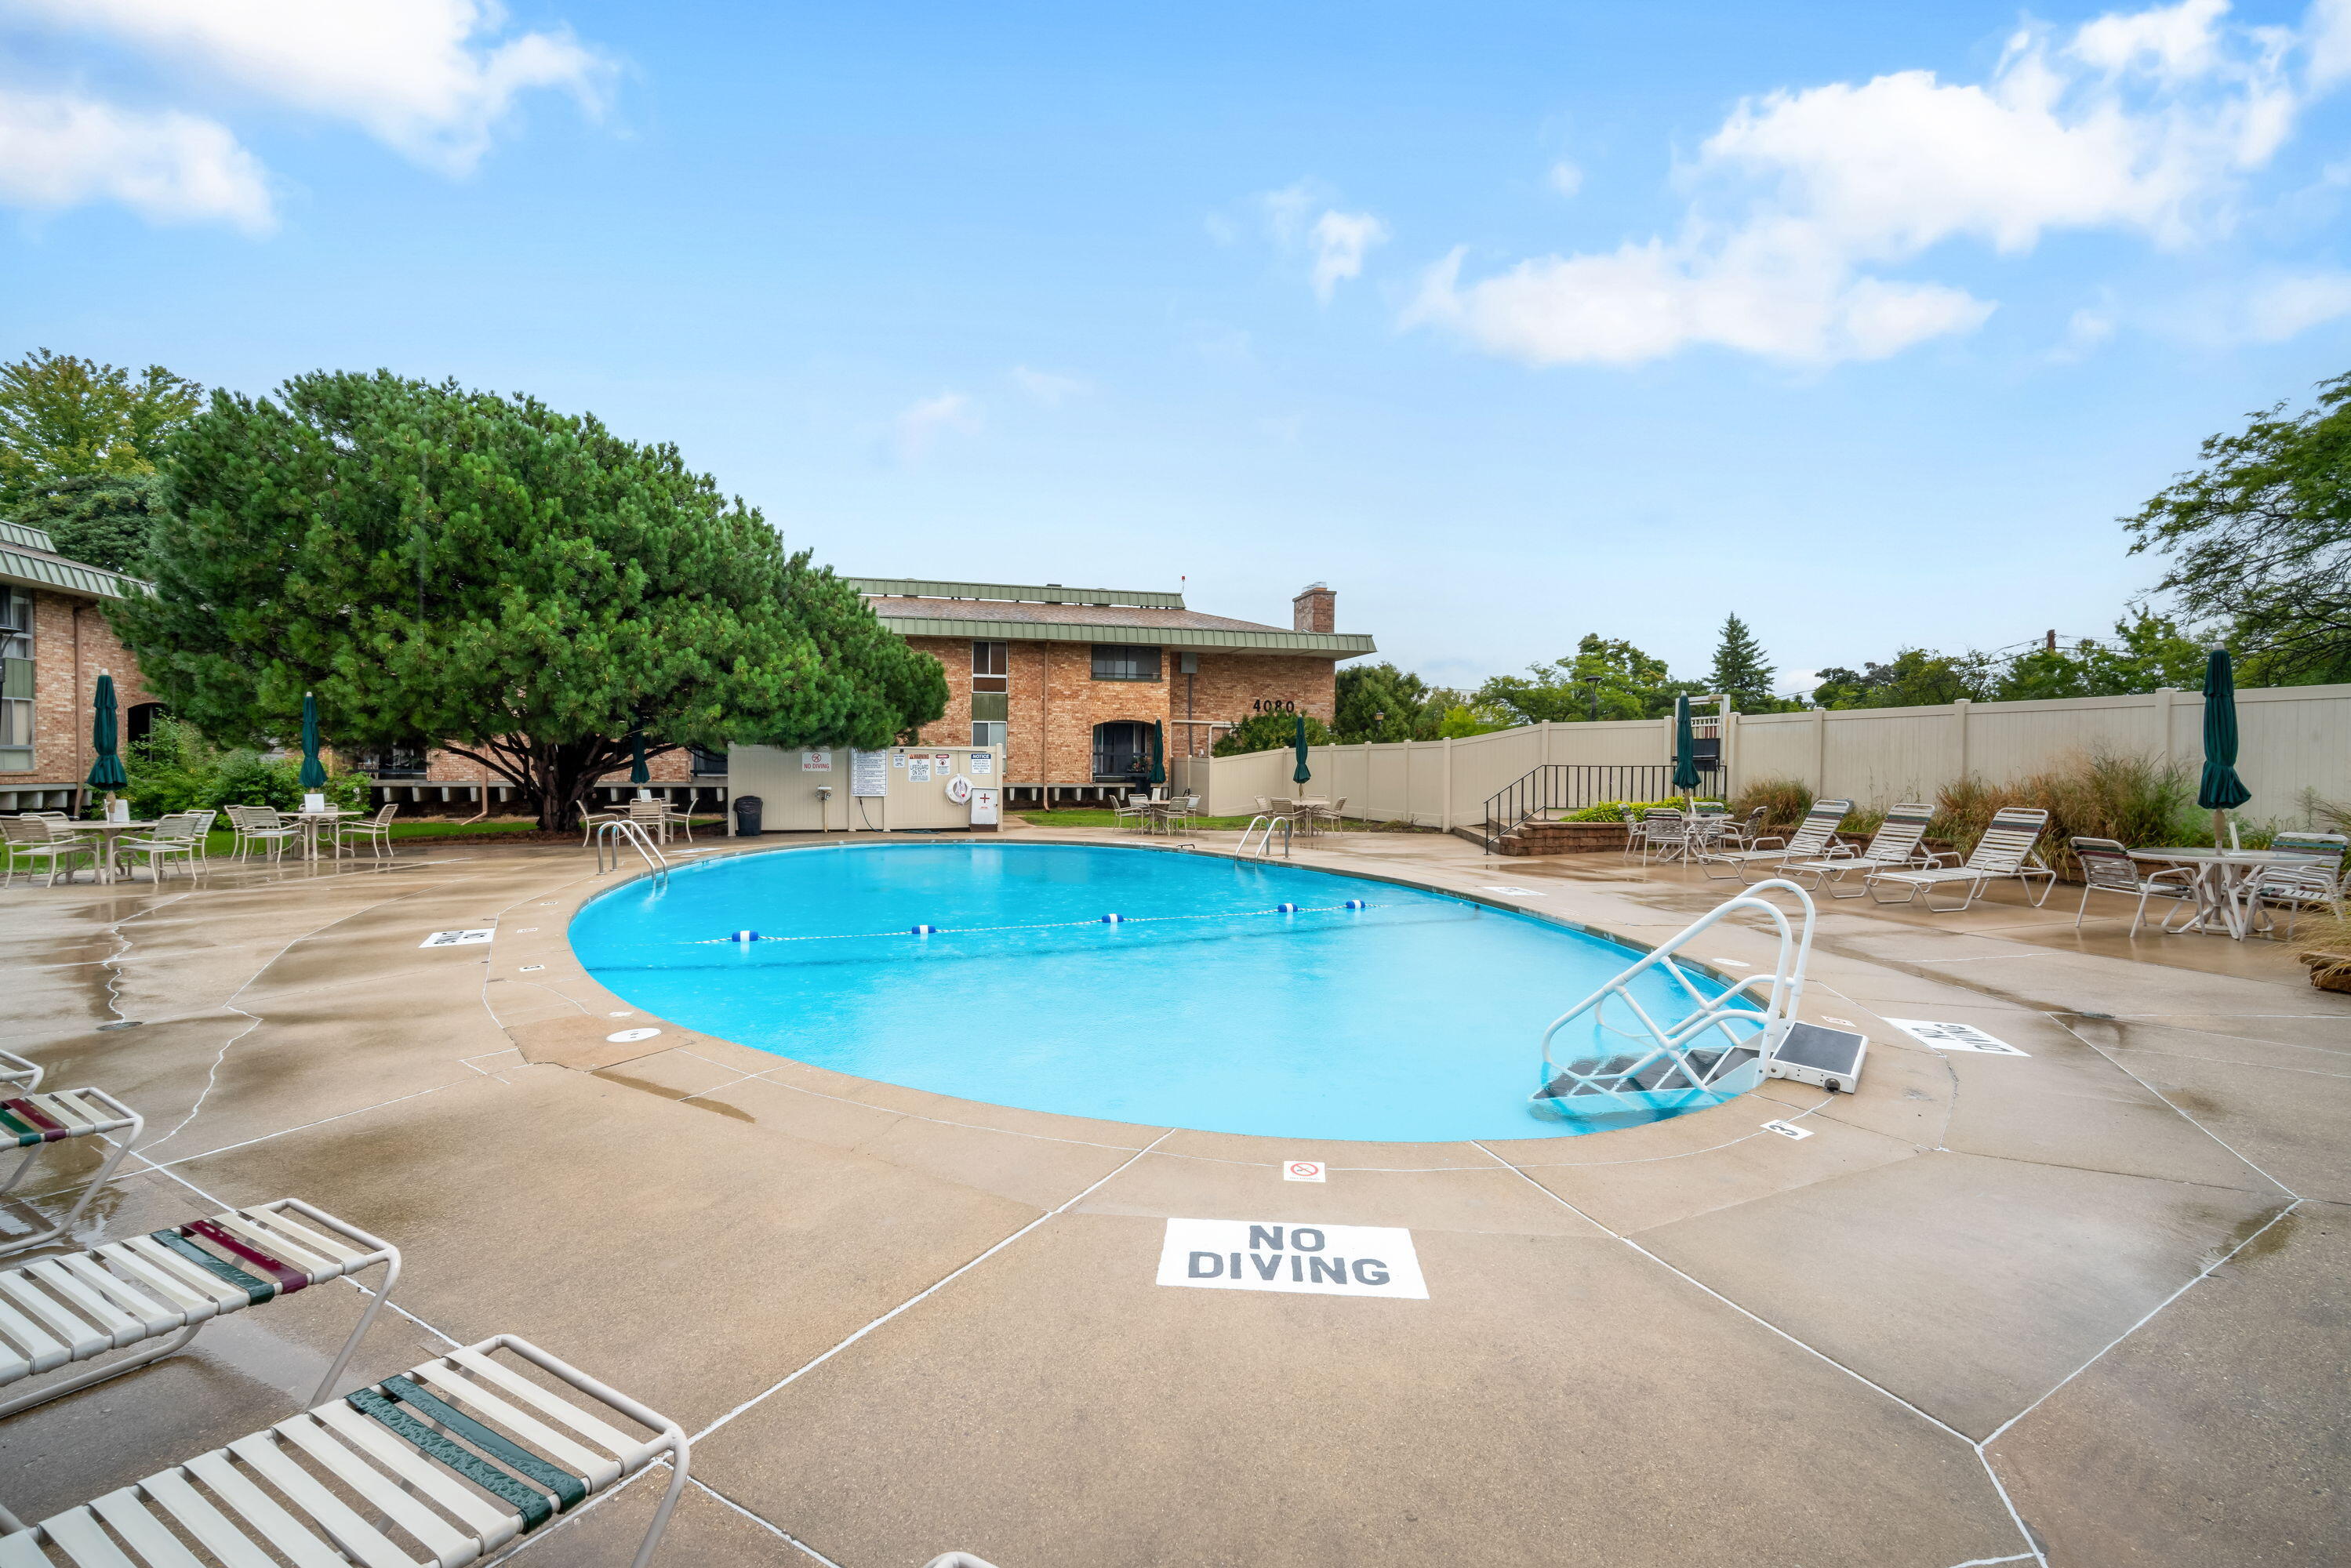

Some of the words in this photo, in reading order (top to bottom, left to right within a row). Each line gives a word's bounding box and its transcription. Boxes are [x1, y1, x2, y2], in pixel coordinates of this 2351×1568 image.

[1253, 699, 1295, 713] 4080
[1249, 1225, 1325, 1252] NO
[1188, 1251, 1390, 1286] DIVING
